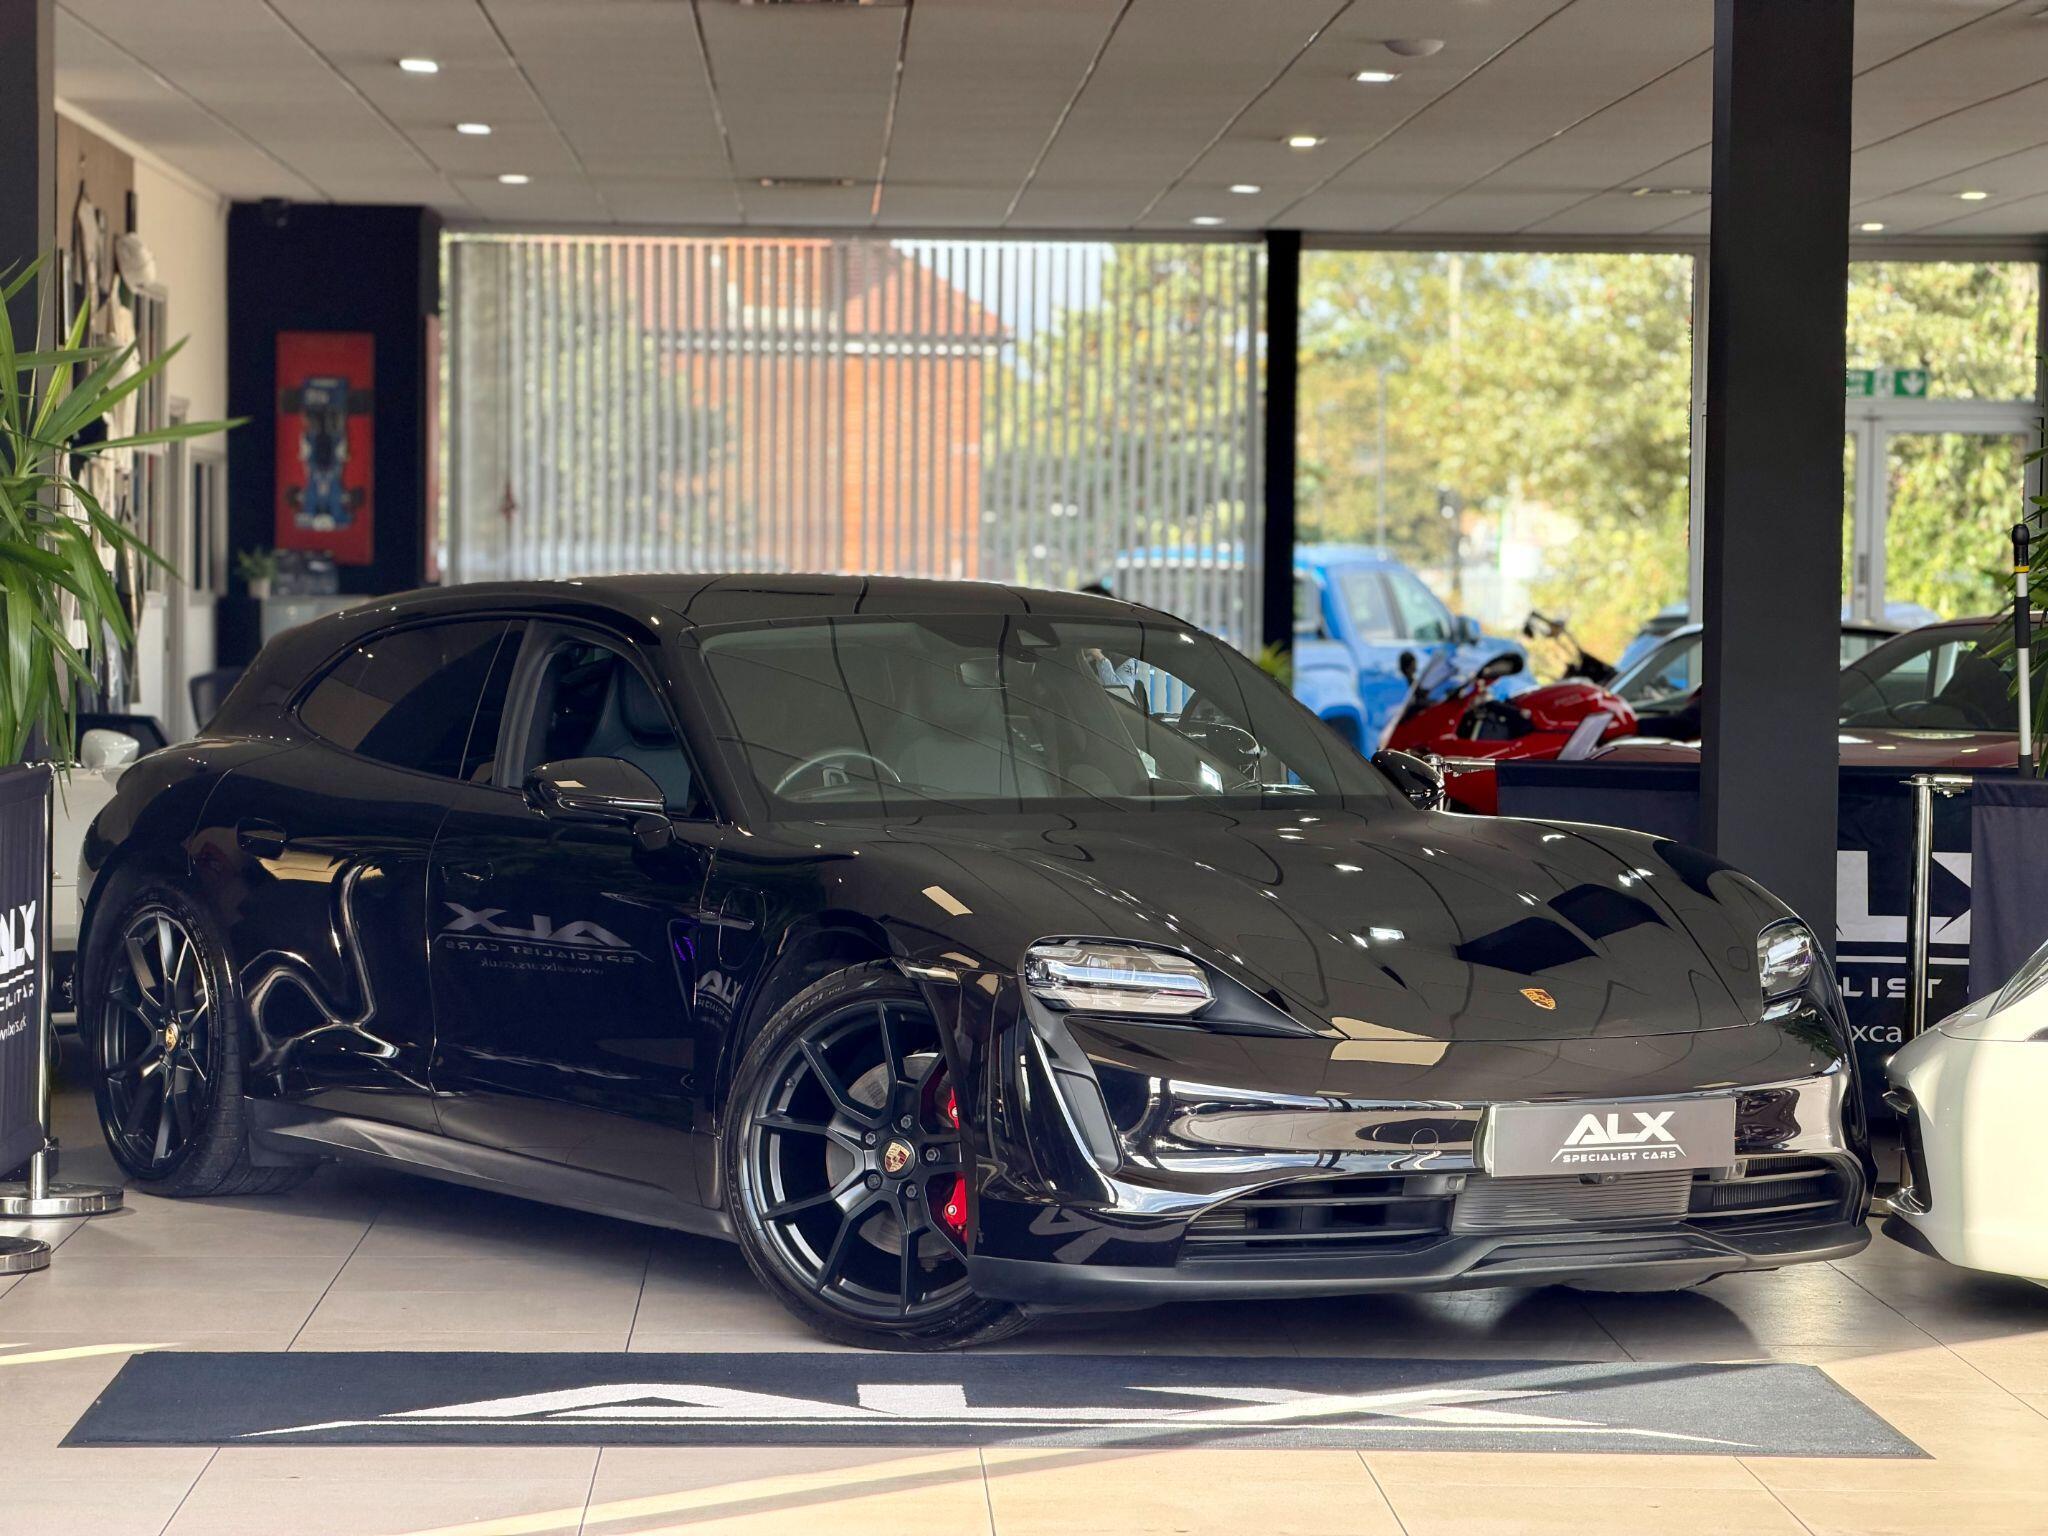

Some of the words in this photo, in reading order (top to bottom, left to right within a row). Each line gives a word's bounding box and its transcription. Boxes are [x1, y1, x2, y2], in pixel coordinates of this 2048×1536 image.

[1843, 976, 1943, 998] LIST
[1851, 1025, 1903, 1043] xca
[1563, 1111, 1677, 1146] ALX
[1562, 1152, 1637, 1163] SPECIALIST
[1642, 1150, 1677, 1160] CARS
[378, 1383, 1608, 1426] ALX
